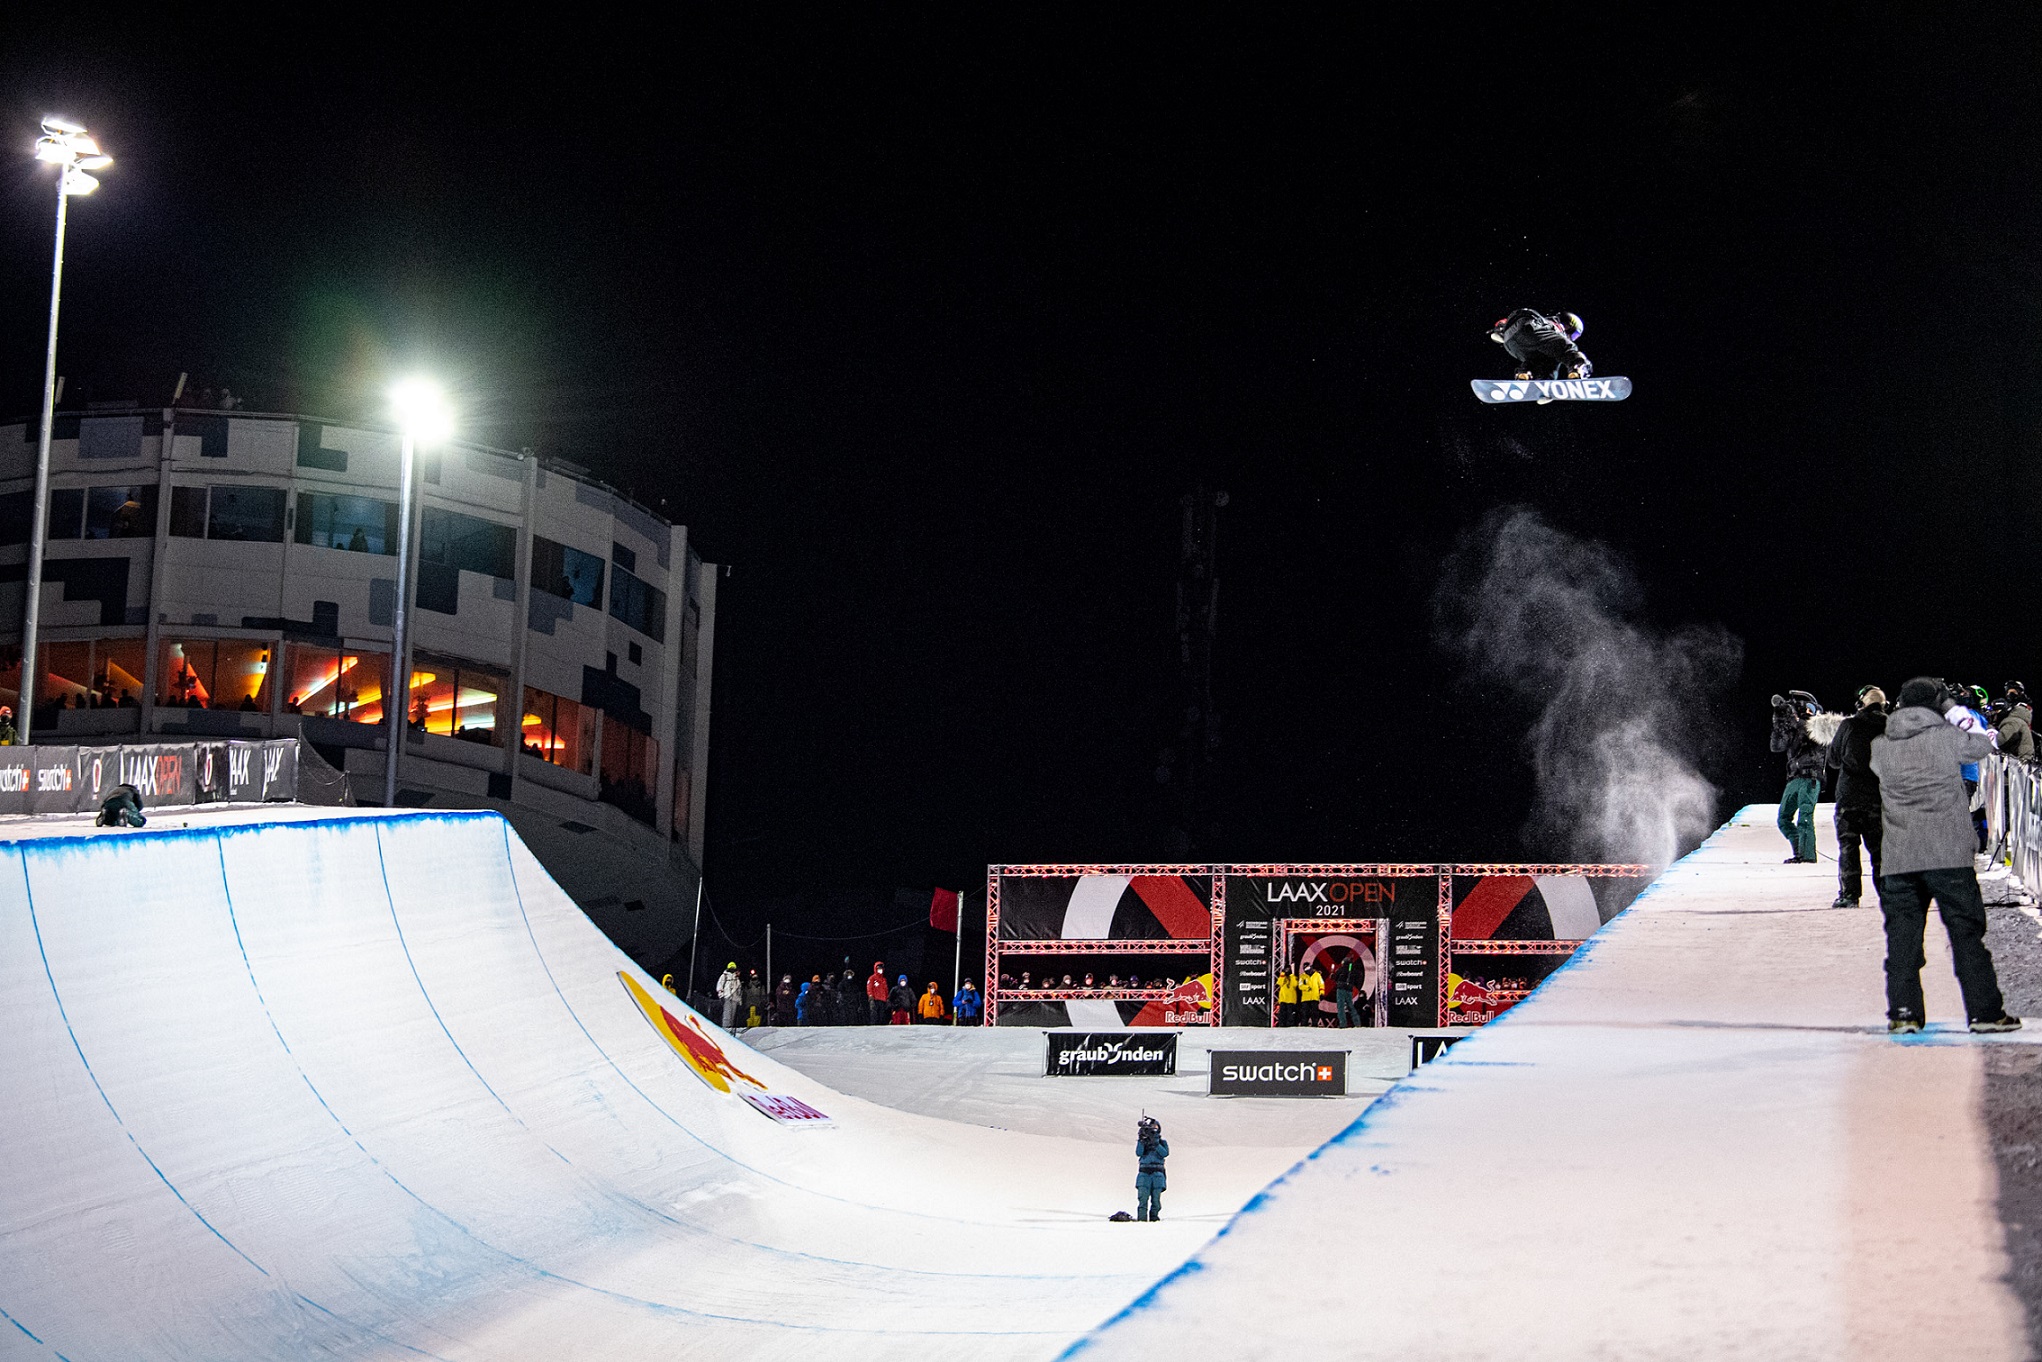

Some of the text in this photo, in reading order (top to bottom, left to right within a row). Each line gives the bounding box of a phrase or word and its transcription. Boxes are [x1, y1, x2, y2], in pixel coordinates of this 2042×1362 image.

[1534, 379, 1617, 400] YONEX
[1267, 881, 1396, 903] LAAX OPEN
[1315, 904, 1345, 916] 2021
[1242, 996, 1266, 1005] LAAX
[1395, 996, 1418, 1006] LAAX
[1222, 1062, 1317, 1082] swatch
